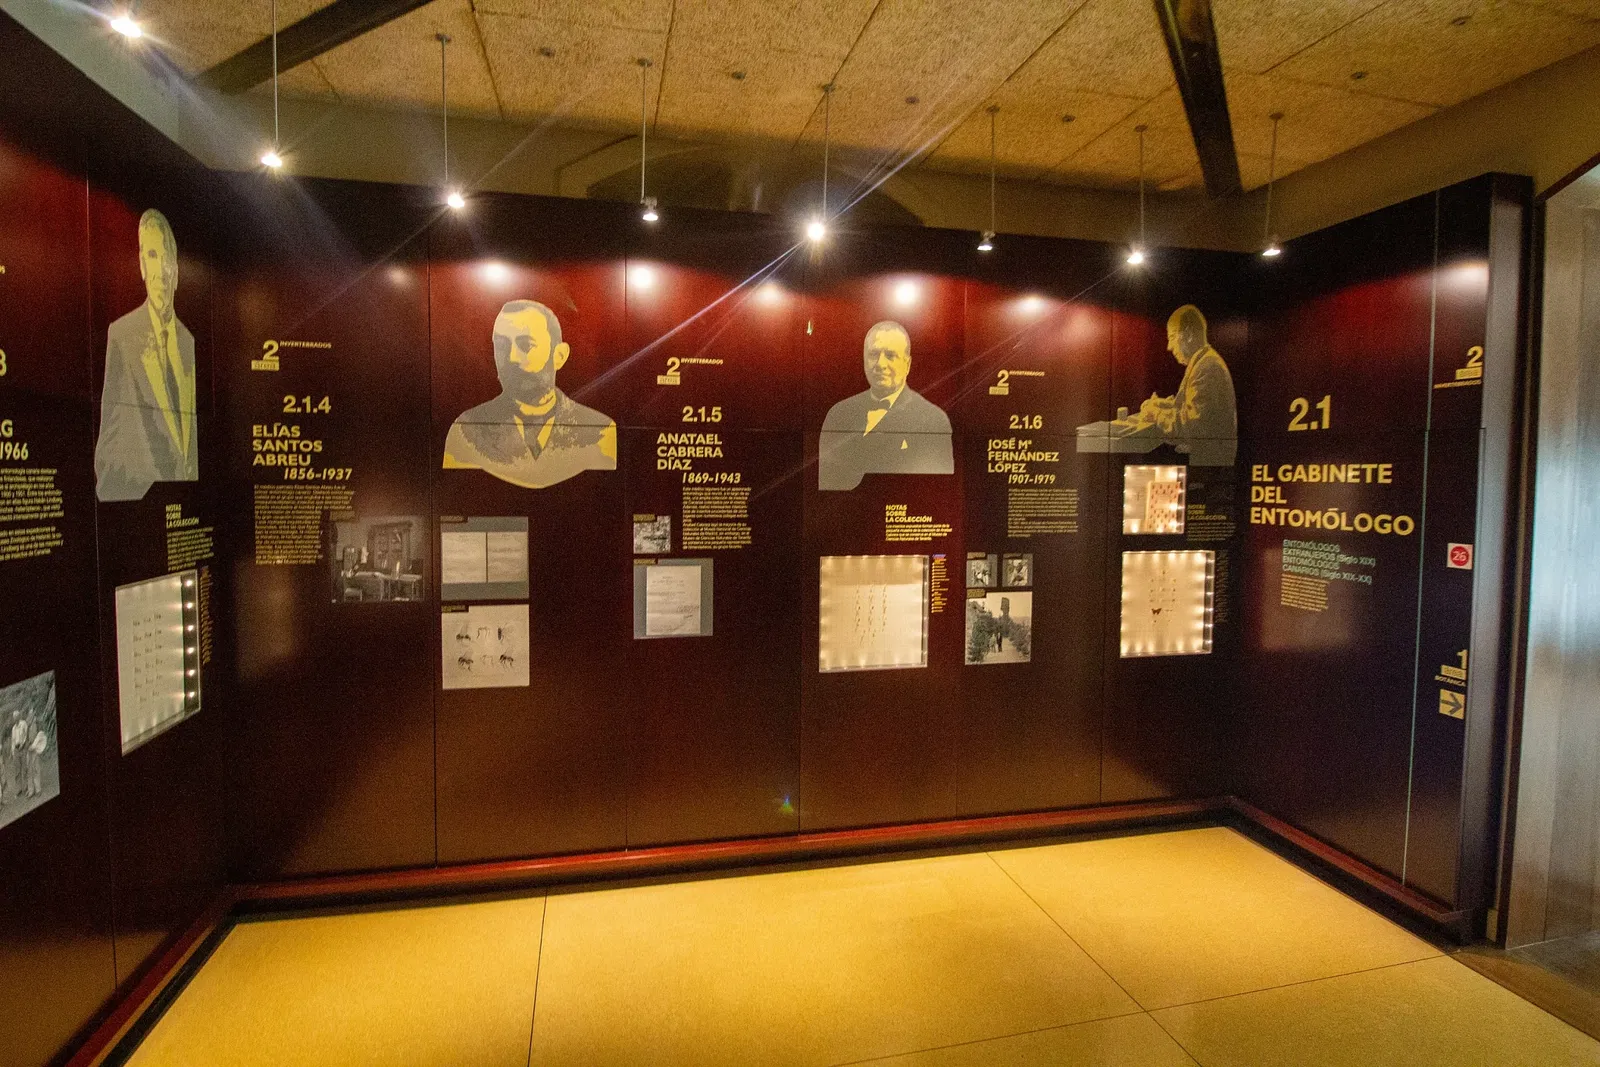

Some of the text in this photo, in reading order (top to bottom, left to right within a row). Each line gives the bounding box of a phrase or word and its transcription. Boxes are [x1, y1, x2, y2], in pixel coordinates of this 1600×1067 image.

[263, 340, 280, 360] 2
[1466, 345, 1484, 368] 2
[666, 357, 680, 376] 2
[997, 369, 1010, 387] 2
[283, 395, 331, 414] 2.1.4
[682, 405, 723, 422] 2.1.5
[1287, 394, 1332, 431] 2.1
[0, 419, 13, 438] G
[1009, 414, 1043, 430] 2.1.6
[252, 422, 301, 438] ELÍAS
[252, 439, 323, 452] SANTOS
[657, 433, 723, 445] ANATAEL
[987, 437, 1016, 451] JOSÉ
[657, 446, 723, 458] CABRERA
[988, 450, 1060, 462] FERNÁNDEZ
[252, 453, 311, 466] ABREU
[657, 457, 692, 470] DÍAZ
[284, 468, 353, 480] 1856-1937
[988, 461, 1027, 473] LÓPEZ
[1251, 464, 1393, 484] EL GABINETE
[682, 472, 742, 484] 1869-1943
[1008, 474, 1056, 484] 1907-1979
[1251, 486, 1288, 504] DEL
[895, 515, 933, 523] COLECCIÓN
[1250, 507, 1415, 536] ENTOMÓLOGO
[1283, 539, 1341, 553] ENTOMÓLOGOS
[1283, 547, 1336, 561] EXTRANJEROS
[1452, 550, 1467, 562] 26
[1282, 555, 1340, 570] ENTOMÓLOGOS
[1282, 563, 1320, 576] CANARIOS
[1456, 649, 1468, 669] 1
